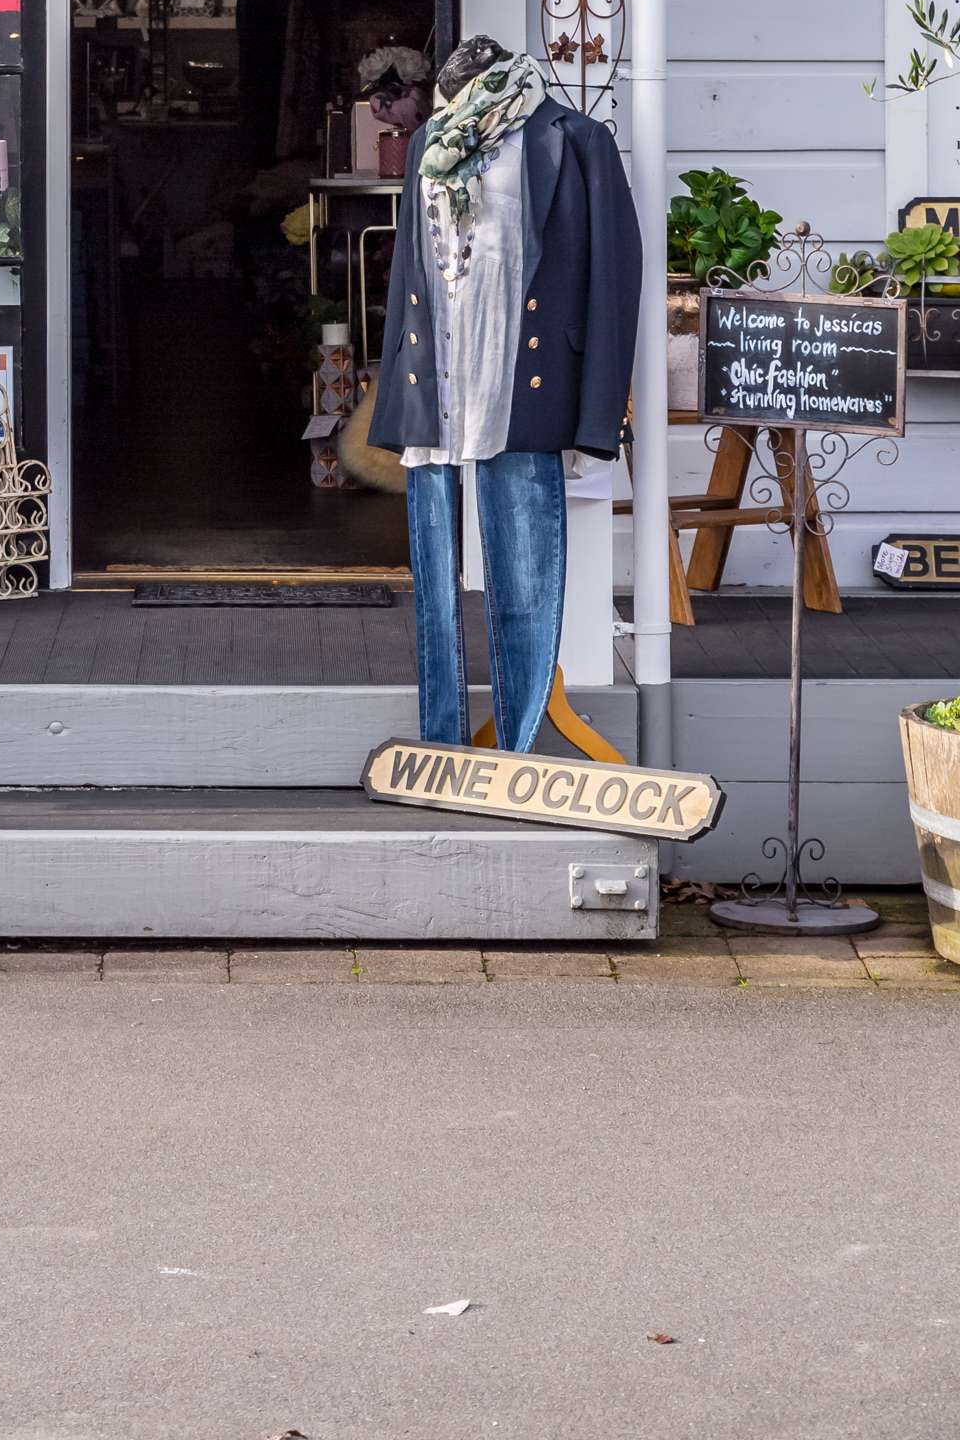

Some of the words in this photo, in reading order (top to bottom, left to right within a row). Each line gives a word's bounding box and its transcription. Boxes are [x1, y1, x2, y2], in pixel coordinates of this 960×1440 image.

[717, 305, 786, 331] Welcome
[793, 307, 810, 331] to
[814, 313, 883, 337] Jessicas
[740, 331, 783, 358] living
[792, 338, 837, 357] room
[390, 750, 497, 800] WINE
[507, 765, 697, 826] O'CLOCK
